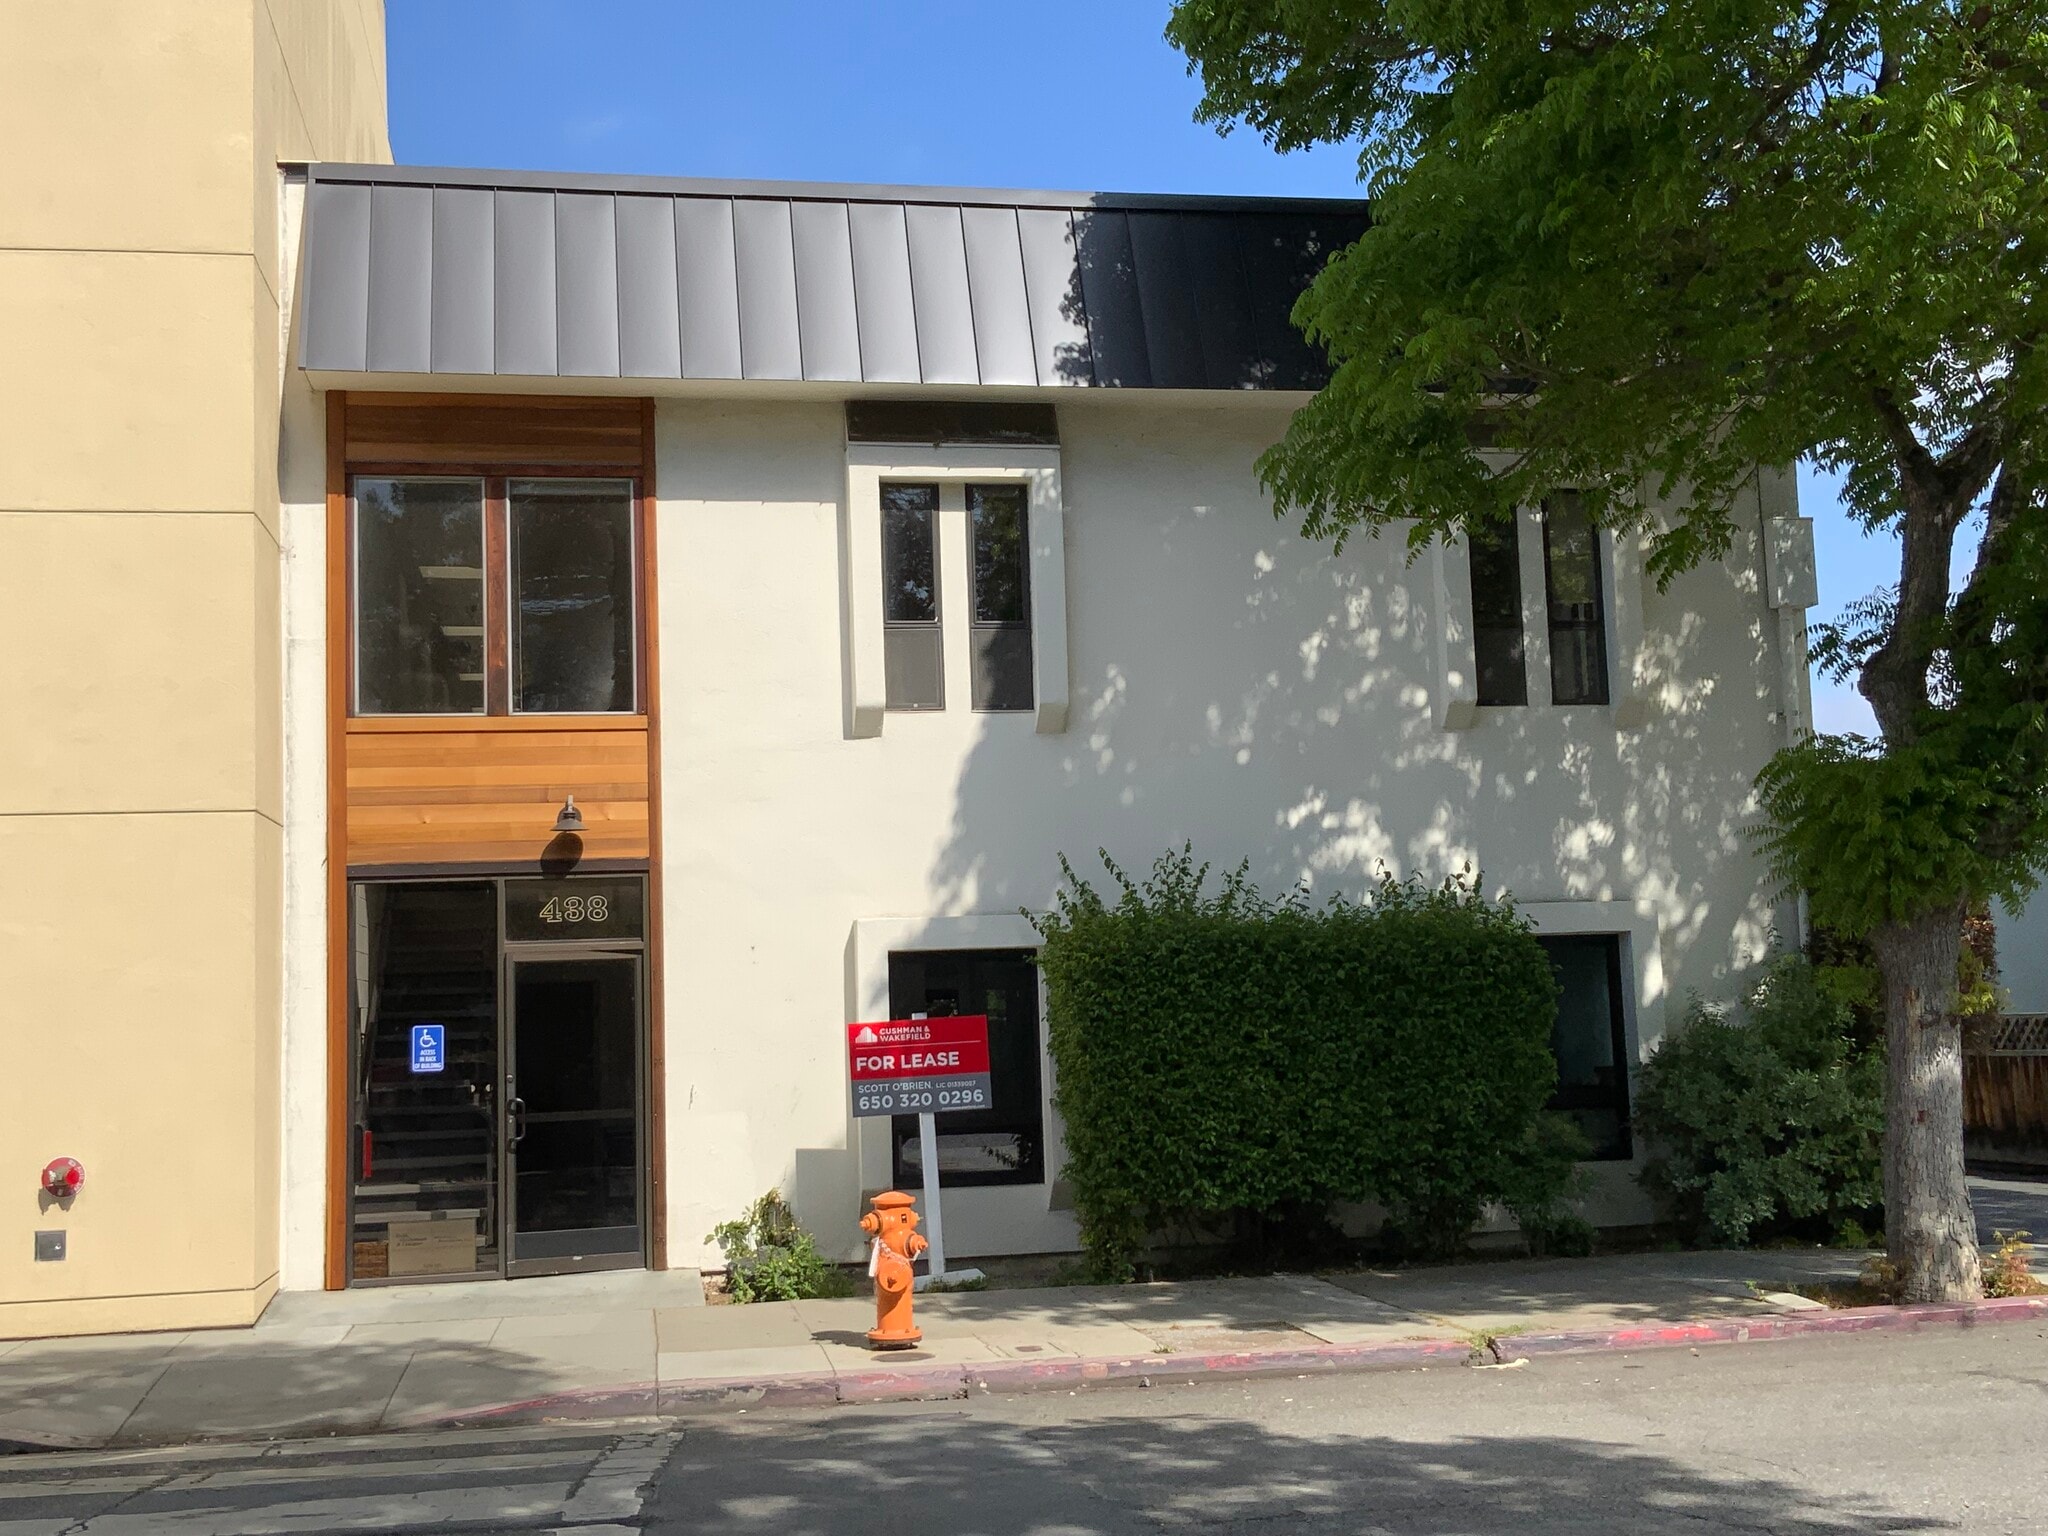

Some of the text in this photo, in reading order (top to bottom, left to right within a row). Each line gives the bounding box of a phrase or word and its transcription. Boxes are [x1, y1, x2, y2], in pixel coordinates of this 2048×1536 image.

[540, 895, 608, 923] 438
[880, 1033, 931, 1042] WAKEFIELD
[856, 1052, 960, 1071] FOR LEASE
[858, 1084, 889, 1093] SCOTT
[859, 1089, 984, 1110] 650 320 0296
